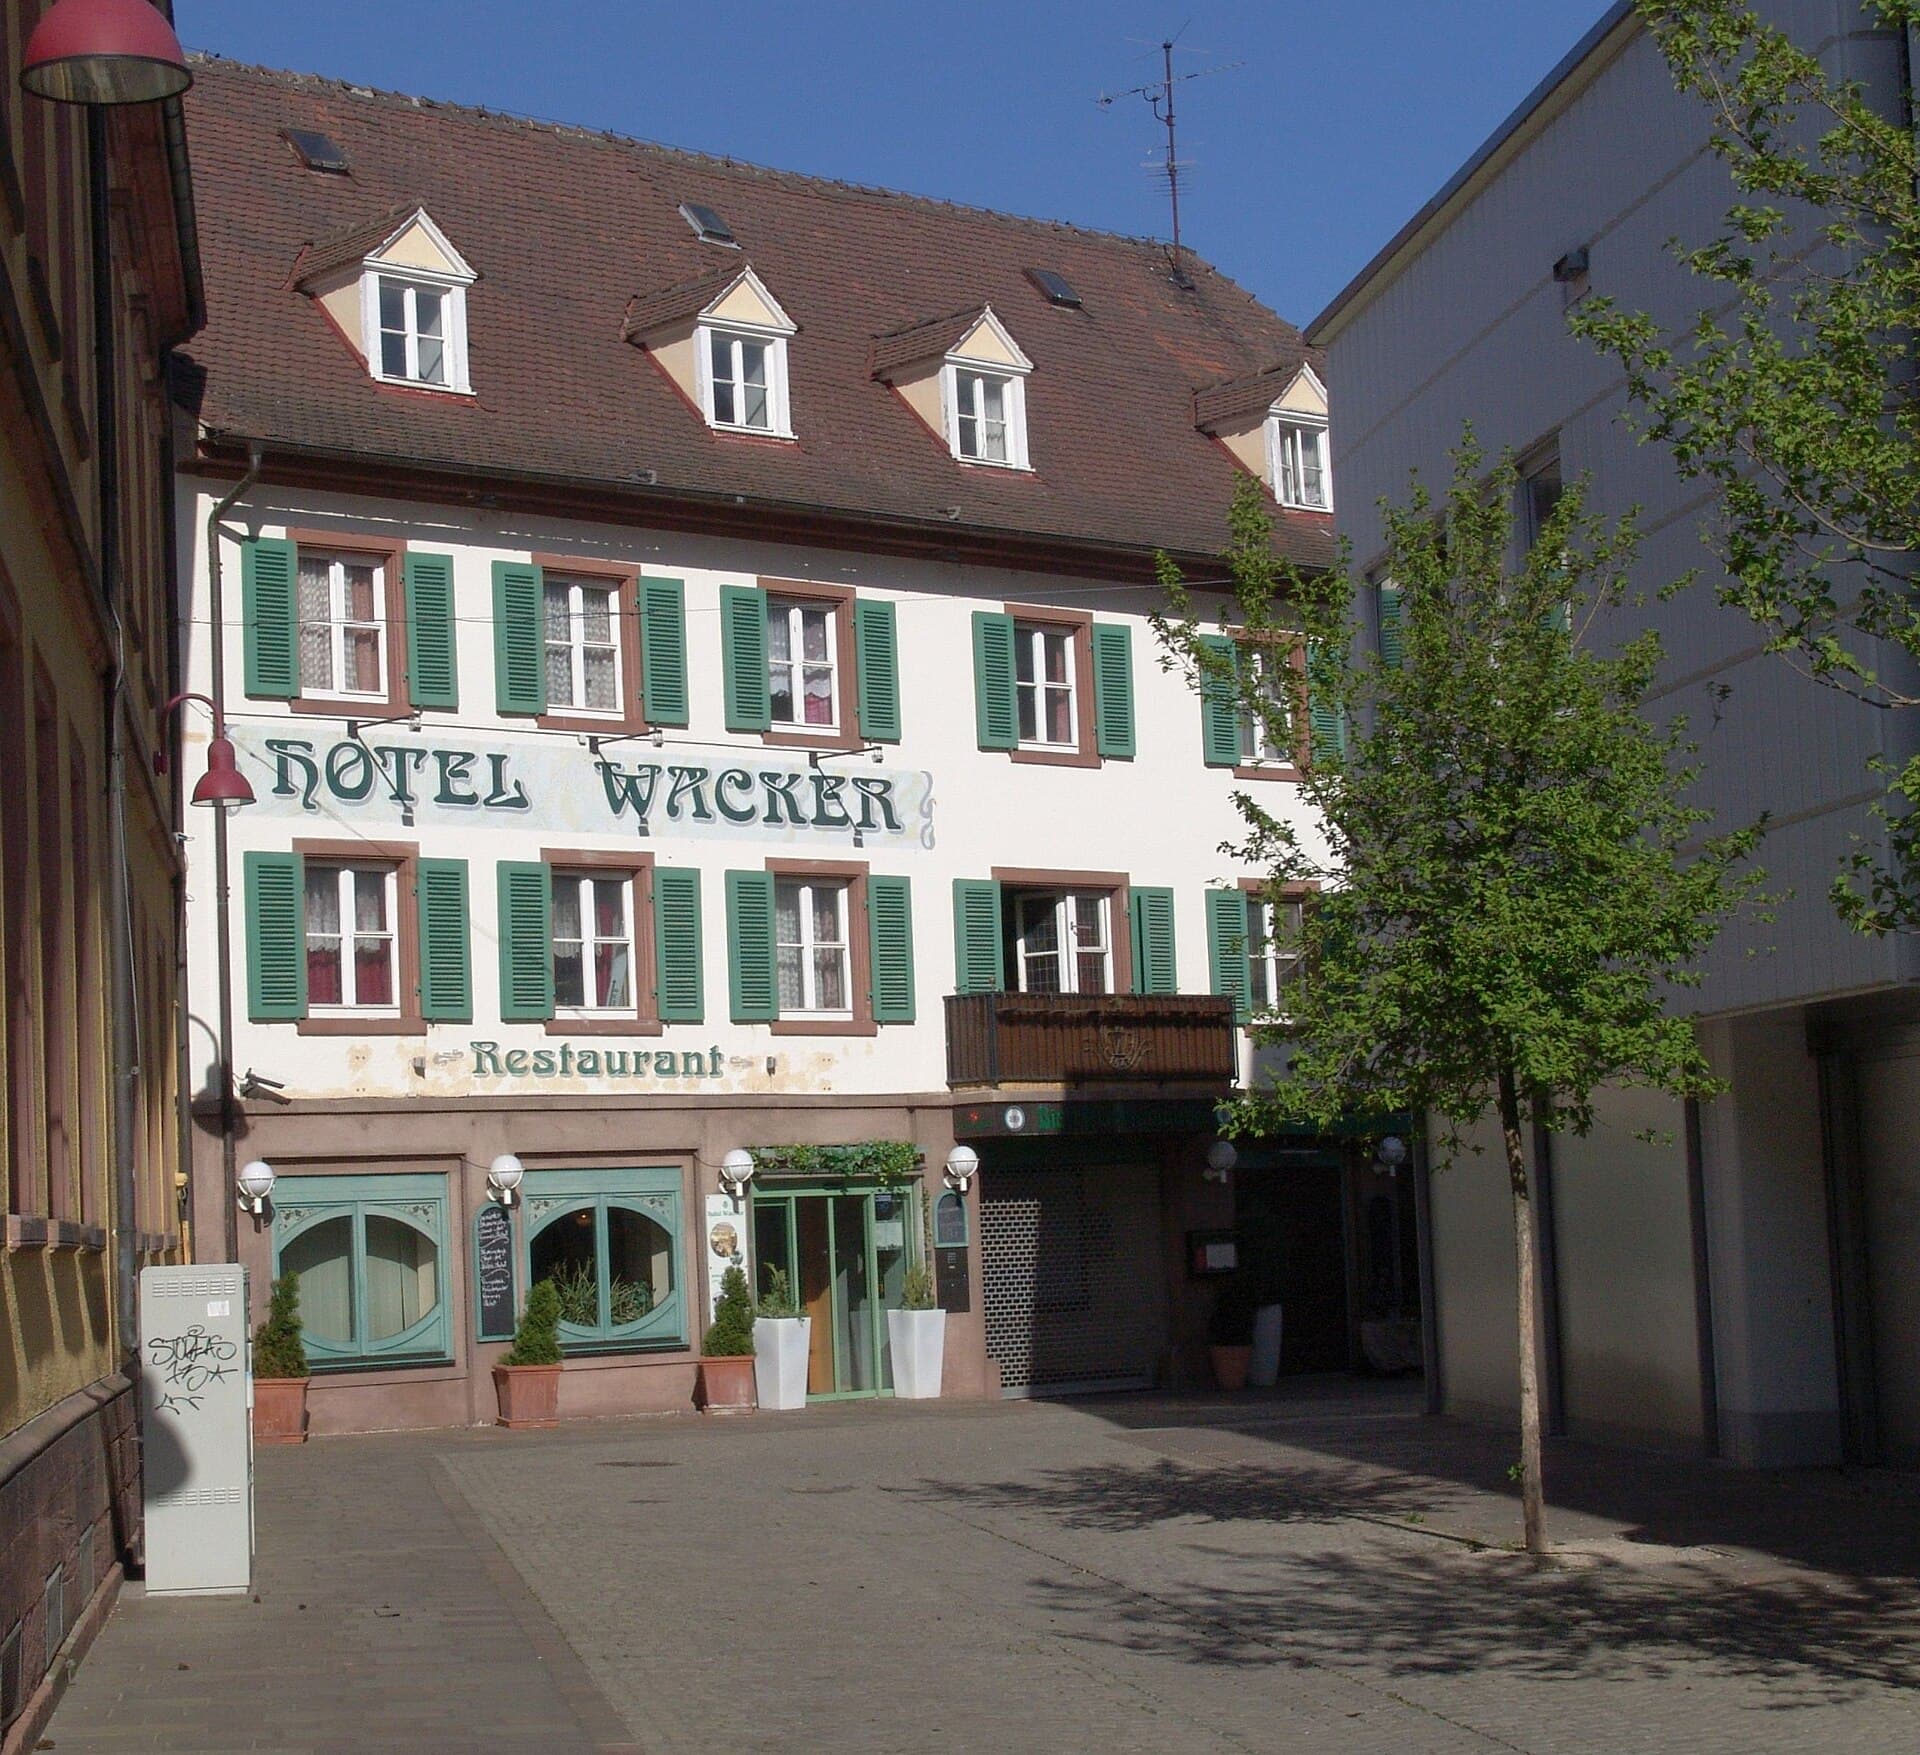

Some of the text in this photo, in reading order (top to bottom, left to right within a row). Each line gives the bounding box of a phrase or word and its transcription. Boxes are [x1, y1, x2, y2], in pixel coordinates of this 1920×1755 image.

[265, 739, 902, 831] HOTEL WACKER
[469, 1041, 725, 1078] Restaurant
